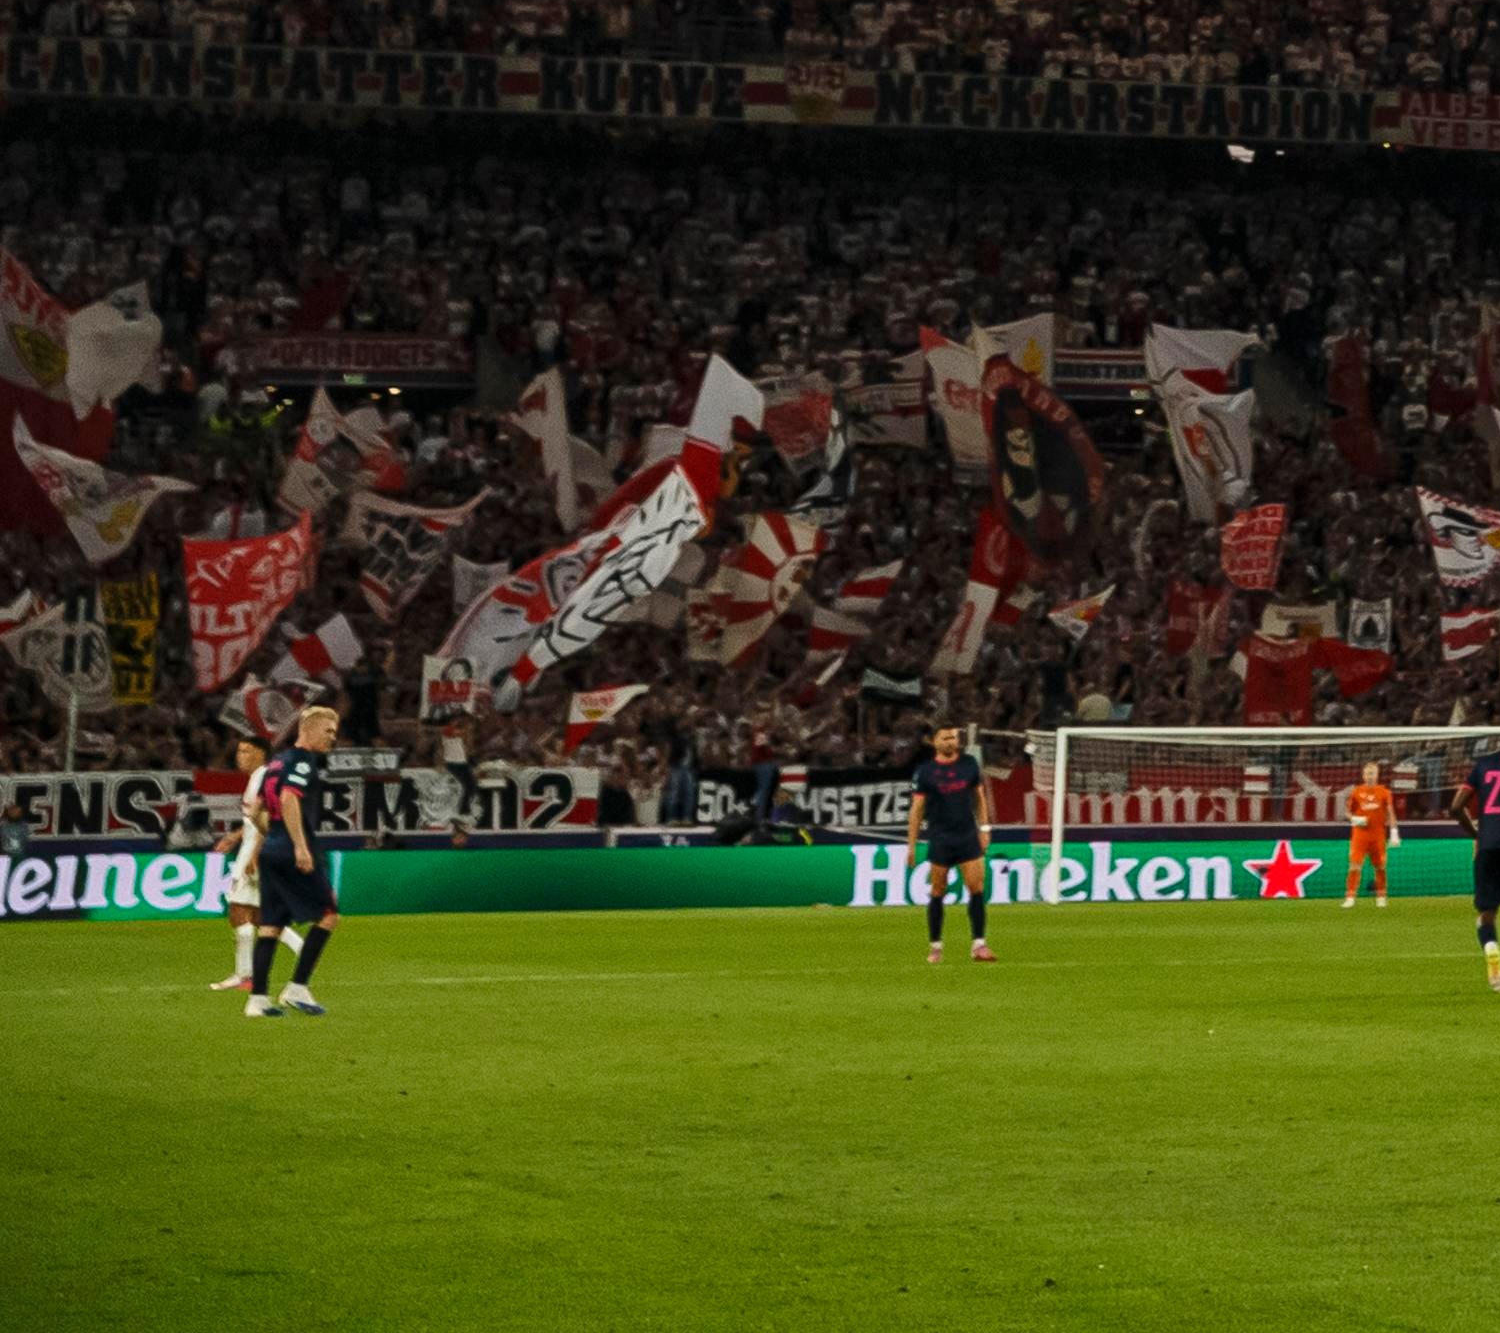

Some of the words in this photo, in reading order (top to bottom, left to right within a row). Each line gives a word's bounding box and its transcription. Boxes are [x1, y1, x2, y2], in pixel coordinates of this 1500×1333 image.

[6, 39, 500, 109] CANNSTATTER
[540, 61, 746, 118] KURVE
[876, 71, 1375, 140] NECKARSTADION
[0, 852, 236, 917] einek
[850, 843, 1235, 906] Heneken
